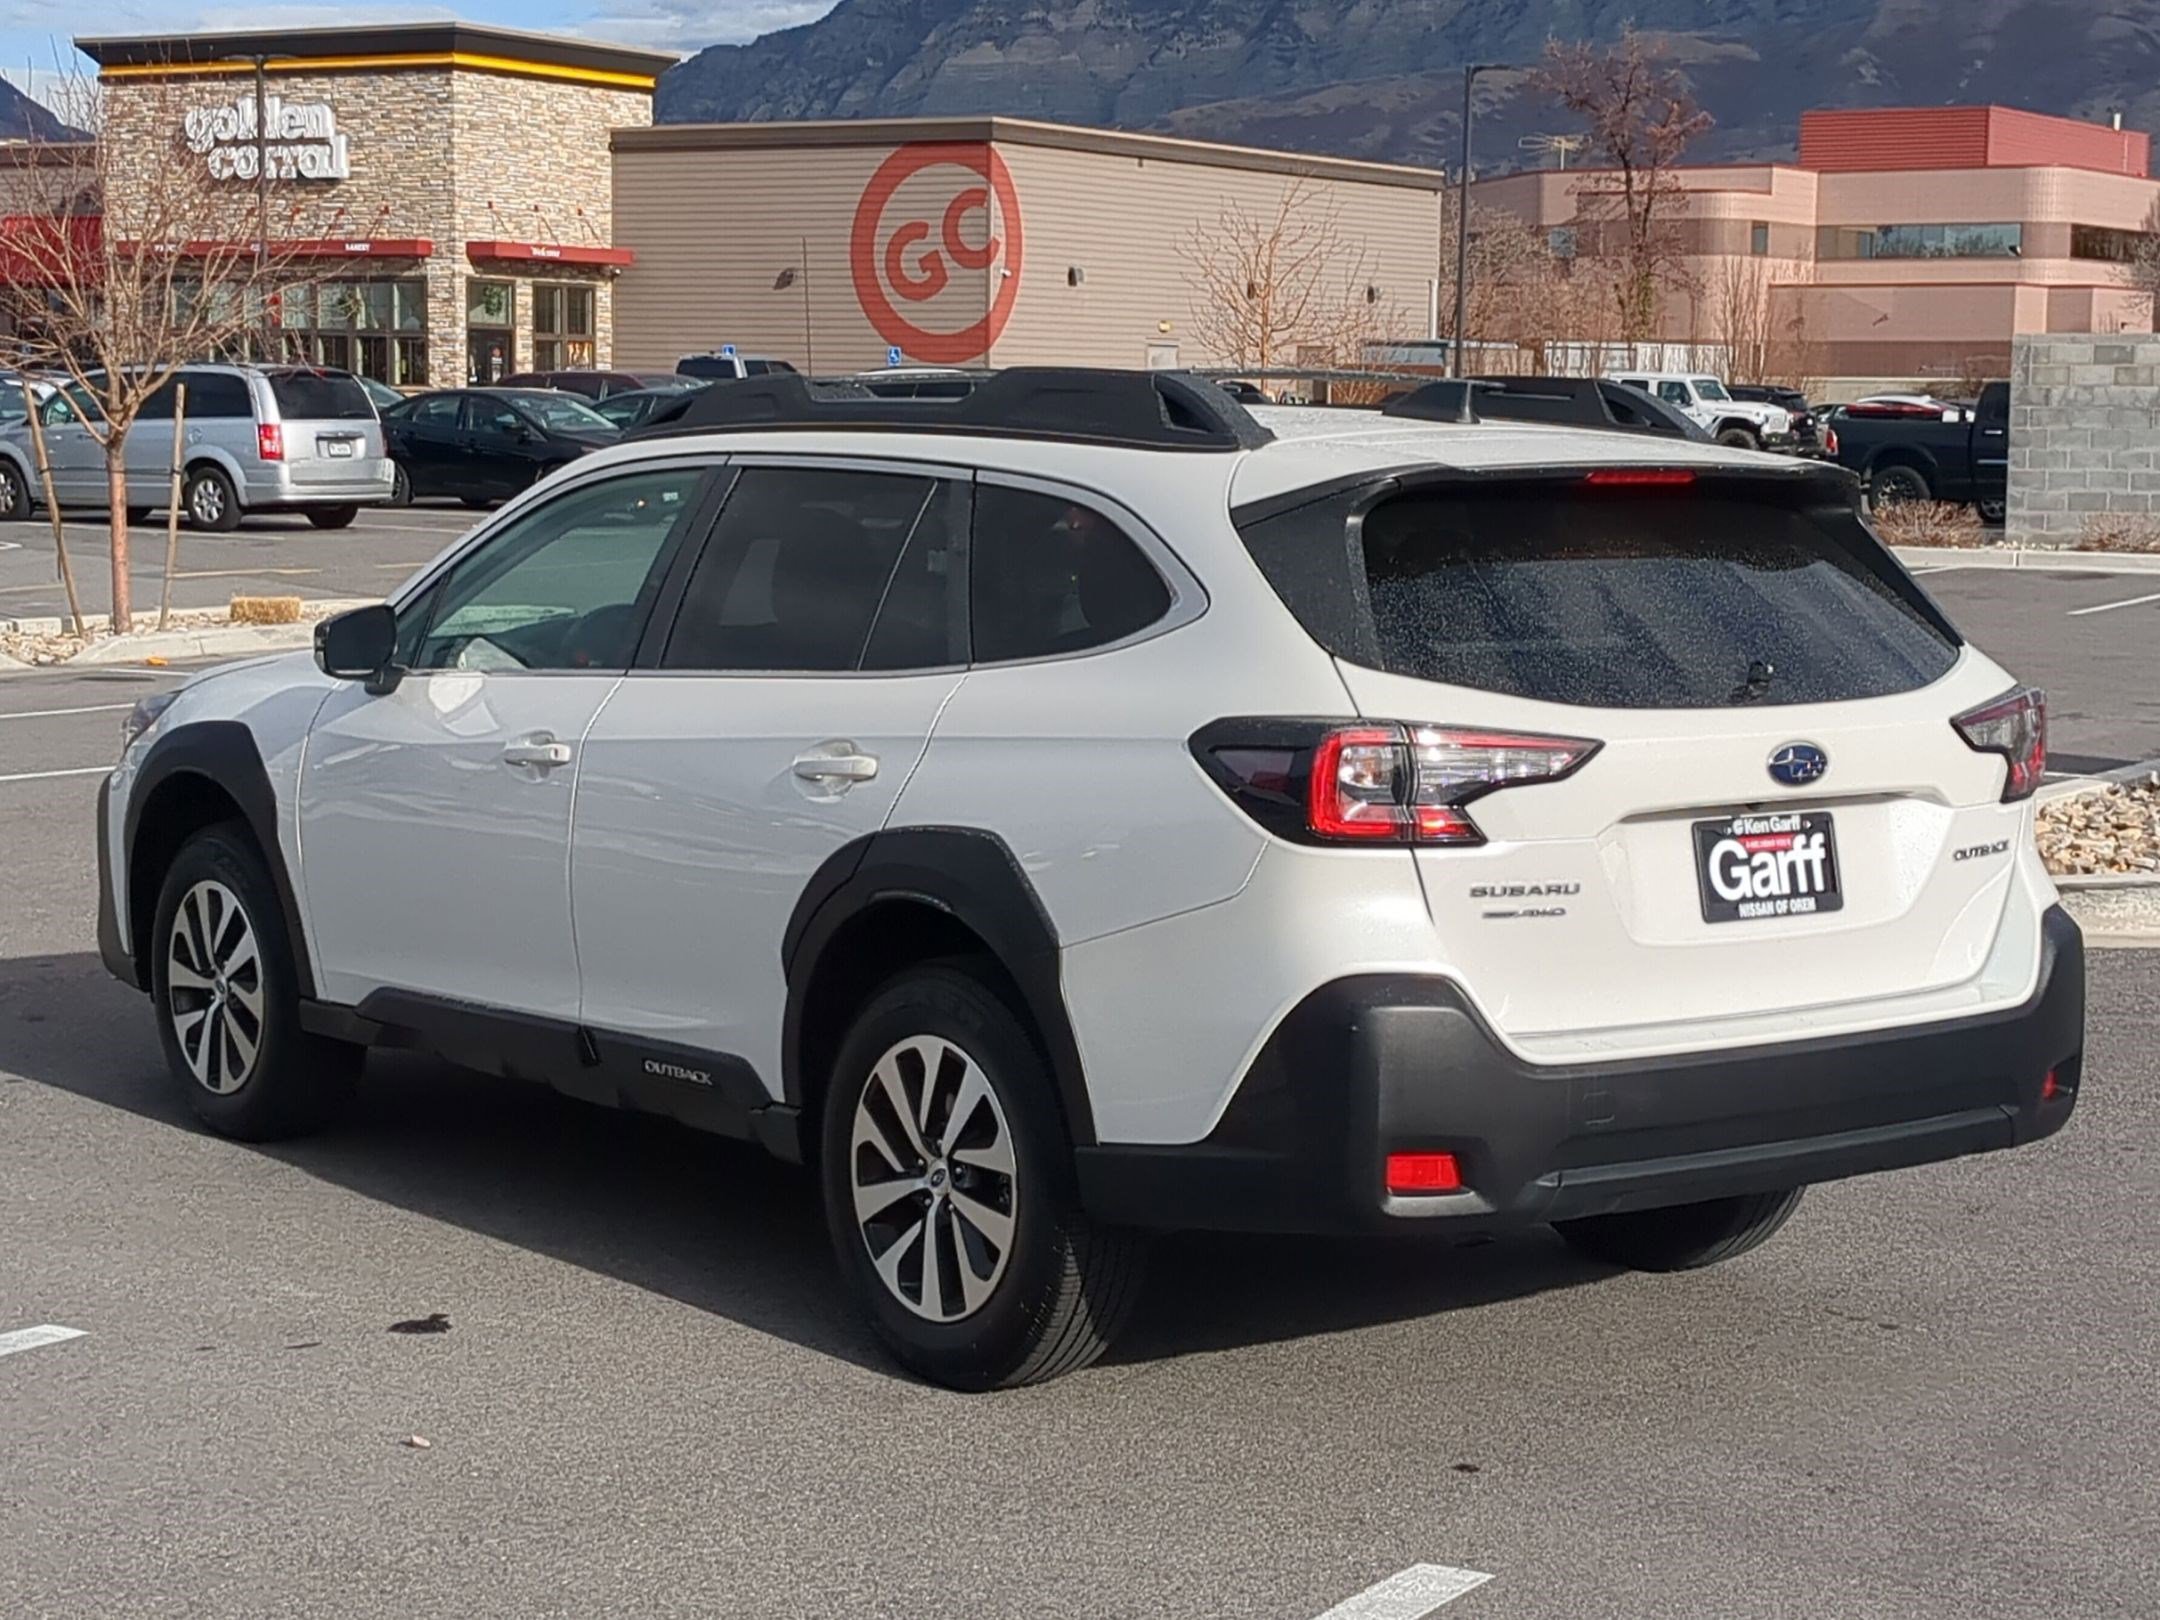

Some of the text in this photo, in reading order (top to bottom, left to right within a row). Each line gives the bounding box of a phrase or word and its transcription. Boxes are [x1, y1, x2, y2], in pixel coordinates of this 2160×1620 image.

[885, 188, 1000, 302] GC
[1744, 817, 1770, 835] Ken
[1770, 814, 1801, 832] Garff
[1953, 839, 2010, 861] OUTBACK
[1709, 833, 1826, 901] Garff
[1469, 883, 1581, 898] SUBARU
[1738, 897, 1817, 918] NISSAN OF OREM
[644, 1059, 713, 1086] OUTBACK
